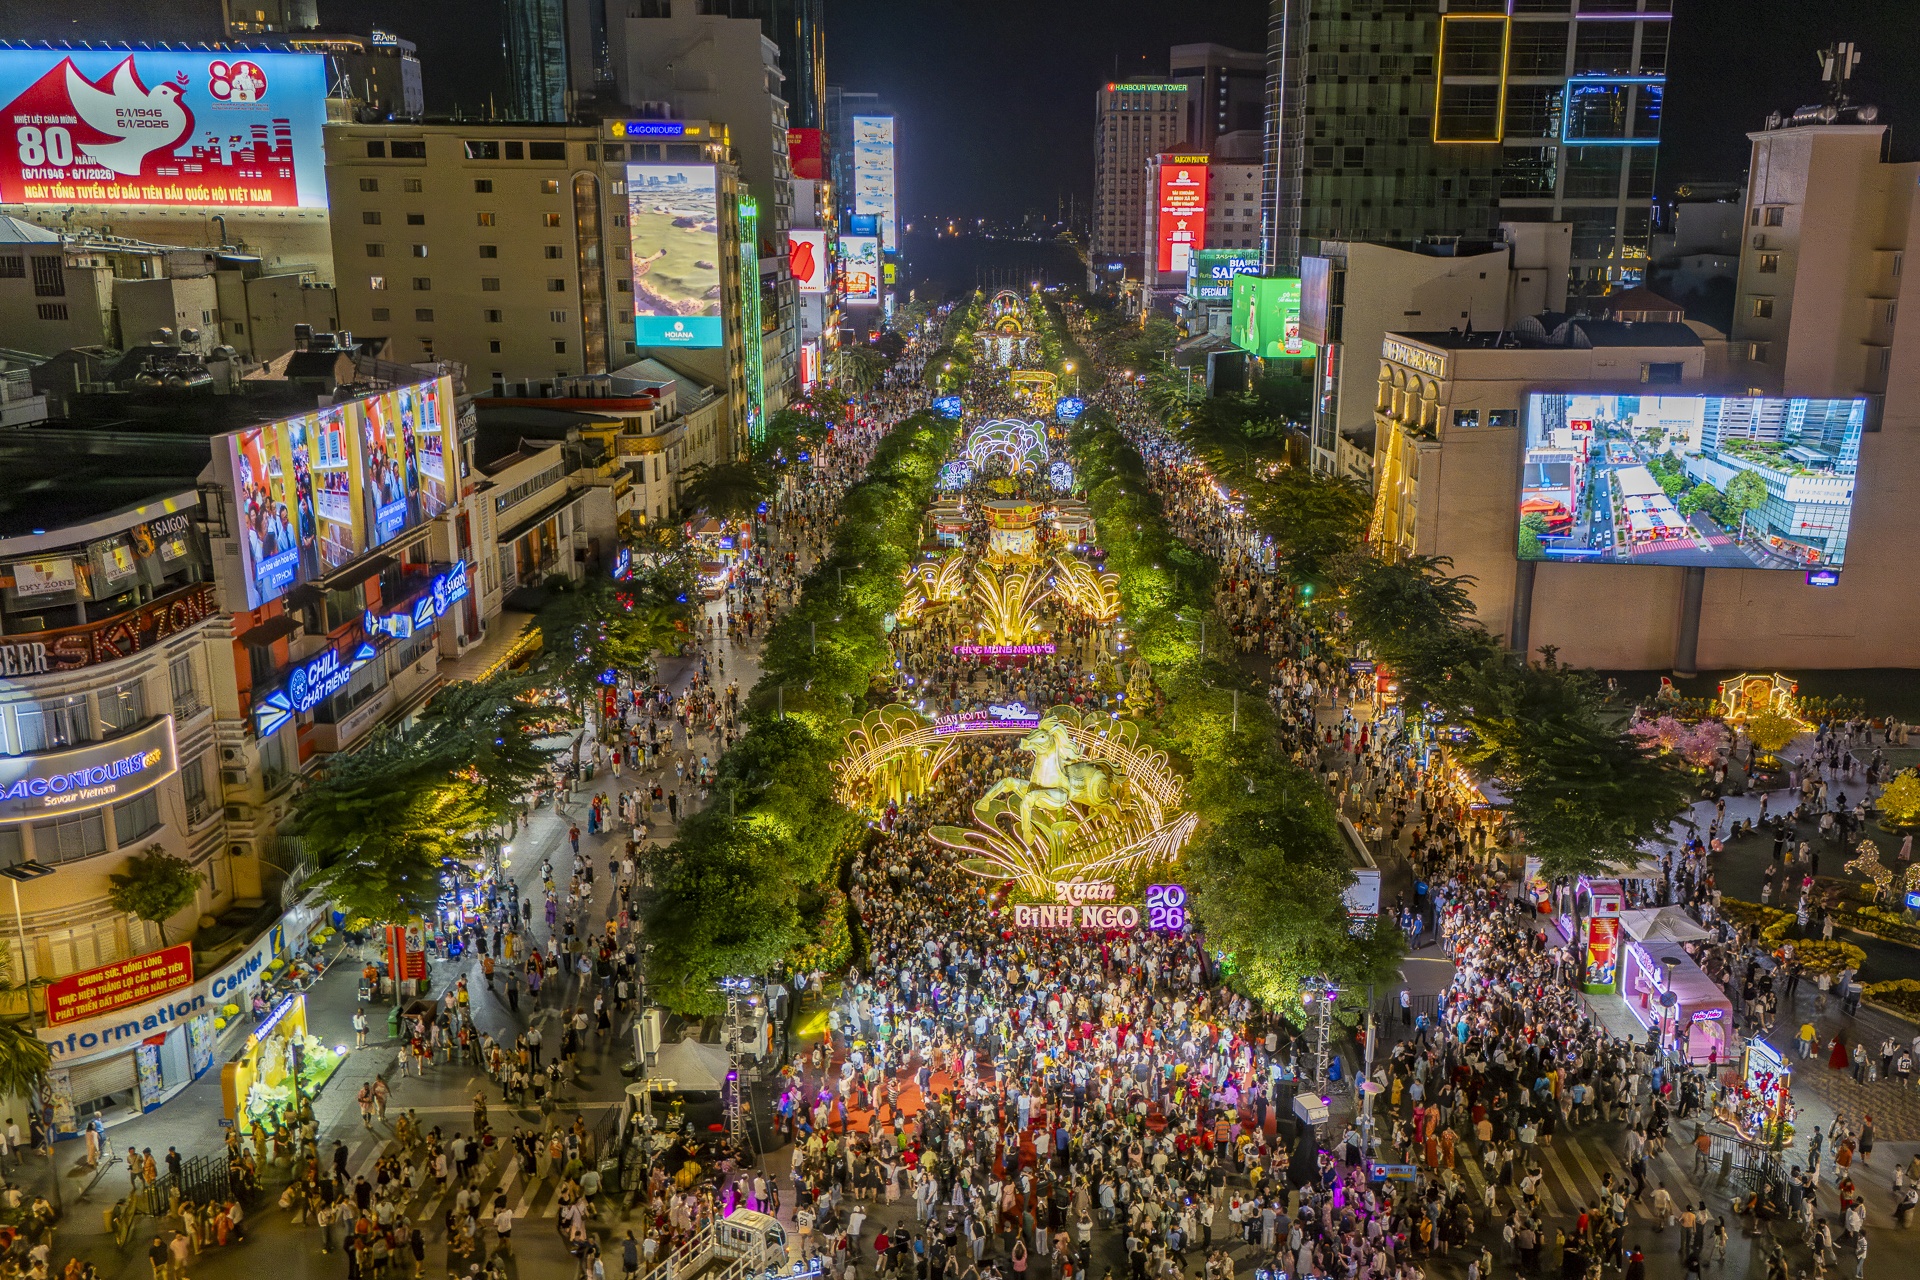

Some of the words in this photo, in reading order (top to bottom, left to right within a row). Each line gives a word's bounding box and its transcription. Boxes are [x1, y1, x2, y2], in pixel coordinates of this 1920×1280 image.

[372, 34, 396, 42] GRAND
[44, 114, 59, 124] CHÀO
[116, 108, 162, 118] 6/1/1946
[118, 120, 169, 128] 6/1/2026
[628, 126, 682, 134] SAIGONTOURIST
[17, 126, 74, 166] 80
[75, 155, 96, 165] NĂM
[1192, 156, 1208, 164] PRINCE
[24, 183, 49, 198] NGÀY
[50, 182, 76, 198] TỔNG
[76, 182, 106, 198] TUYỂN
[107, 182, 121, 199] CỬ
[122, 183, 140, 200] ĐẦU
[142, 184, 162, 200] TIÊN
[164, 184, 184, 200] BẦU
[185, 184, 210, 202] QUỐC
[212, 186, 228, 204] HỘI
[229, 187, 248, 204] VIỆT
[250, 189, 272, 202] NAM
[1230, 259, 1244, 268] BIA
[156, 514, 190, 536] SAIGON
[19, 584, 40, 592] SKY
[44, 580, 75, 588] ZONE
[0, 642, 50, 677] EER
[54, 612, 142, 671] SKY
[153, 590, 220, 642] ZONE
[308, 650, 339, 686] CHILL
[301, 681, 325, 712] CHẤT
[325, 667, 350, 696] RIÊNG
[934, 715, 958, 726] XUÂN
[44, 793, 78, 806] Savour
[79, 784, 116, 800] Vietnam
[1147, 886, 1184, 908] 20
[1150, 907, 1183, 929] 26
[78, 972, 104, 988] CHUNG
[105, 966, 122, 980] SỨC,
[122, 961, 142, 975] ĐỒNG
[144, 956, 162, 968] LÒNG
[58, 993, 77, 1006] THỰC
[78, 988, 96, 1002] HIỆN
[98, 980, 122, 994] THẮNG
[122, 976, 134, 989] LỢI
[135, 971, 150, 984] CÁC
[150, 967, 167, 980] MỤC
[168, 962, 183, 974] TIÊU
[46, 994, 206, 1056] nformation
[212, 951, 263, 998] Center
[55, 1008, 75, 1020] PHÁT
[76, 1002, 98, 1014] TRIỂN
[99, 996, 113, 1008] ĐẤT
[114, 992, 134, 1004] NƯỚC
[134, 985, 150, 997] ĐẾN
[150, 980, 167, 993] NĂM
[168, 974, 188, 986] 2030!
[800, 1218, 808, 1226] 23
